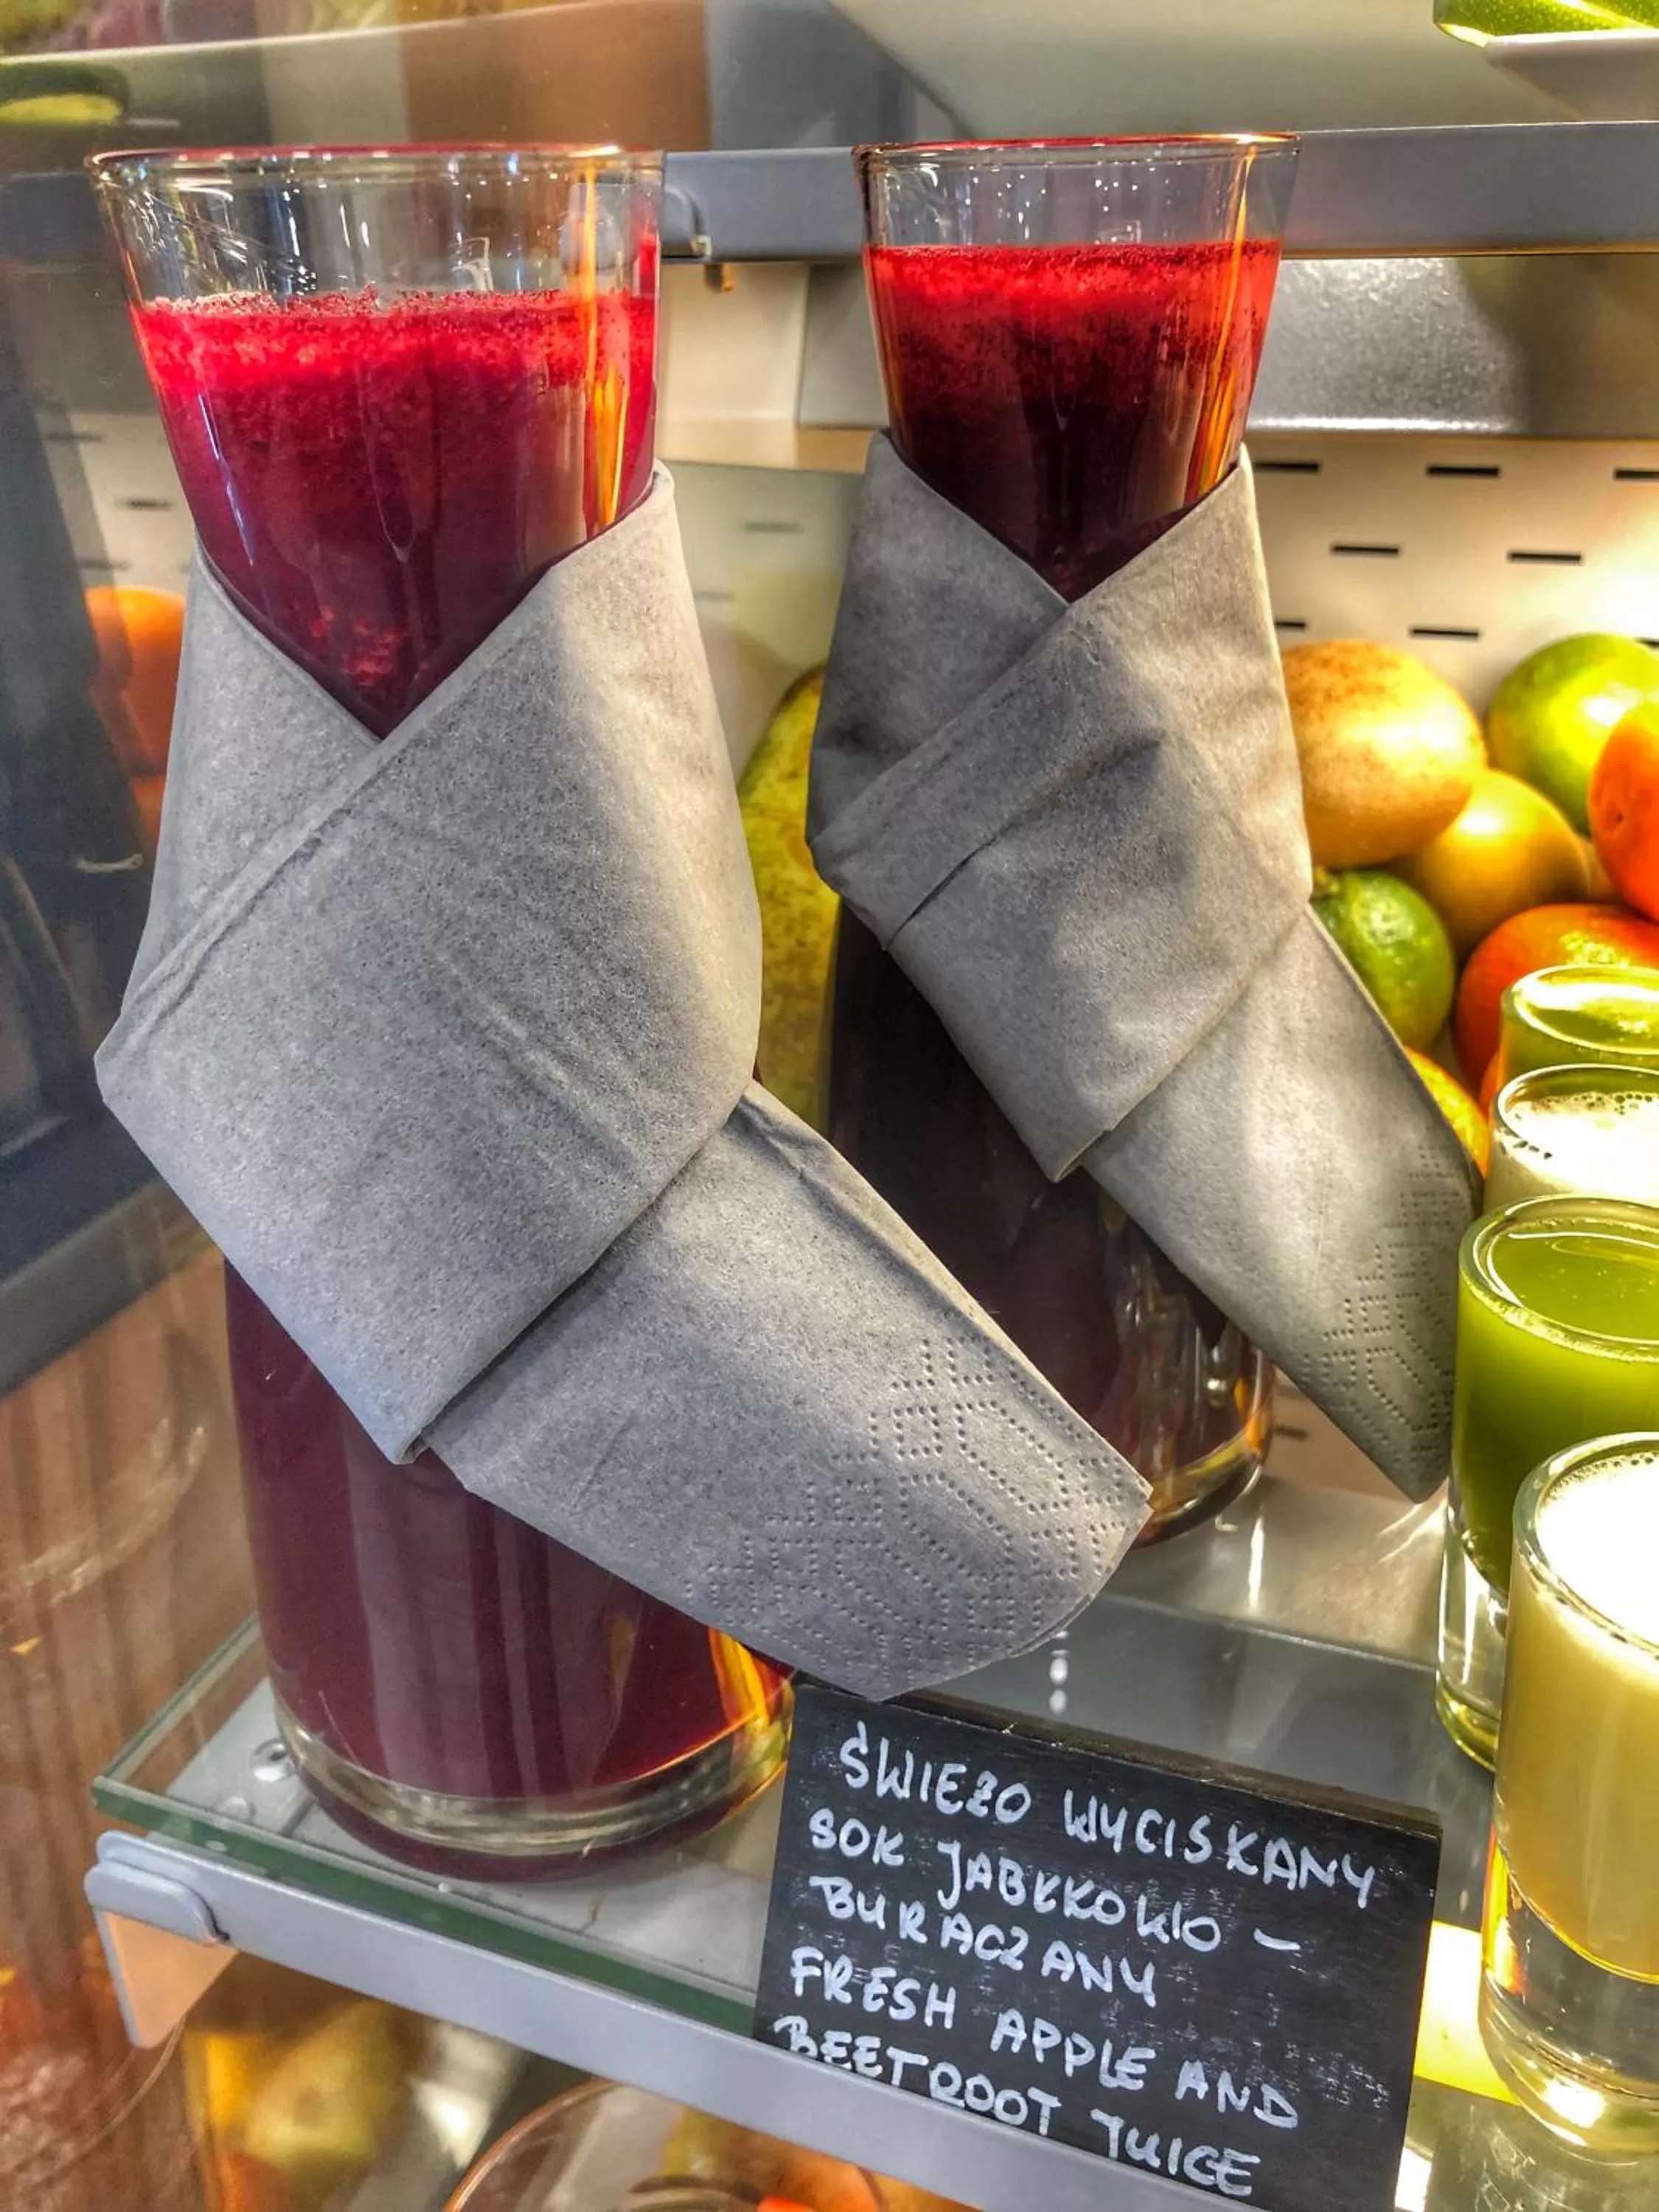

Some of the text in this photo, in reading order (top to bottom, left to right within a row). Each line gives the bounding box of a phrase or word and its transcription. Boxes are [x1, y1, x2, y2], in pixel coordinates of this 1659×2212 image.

[809, 1808, 905, 1867] SOK
[1064, 1789, 1375, 1909] WYCISKANY
[809, 1875, 1157, 2008] BURACZANY
[790, 1946, 1298, 2129] FRESH APPLE AND
[773, 2015, 1262, 2197] BEETROOT JUICE
